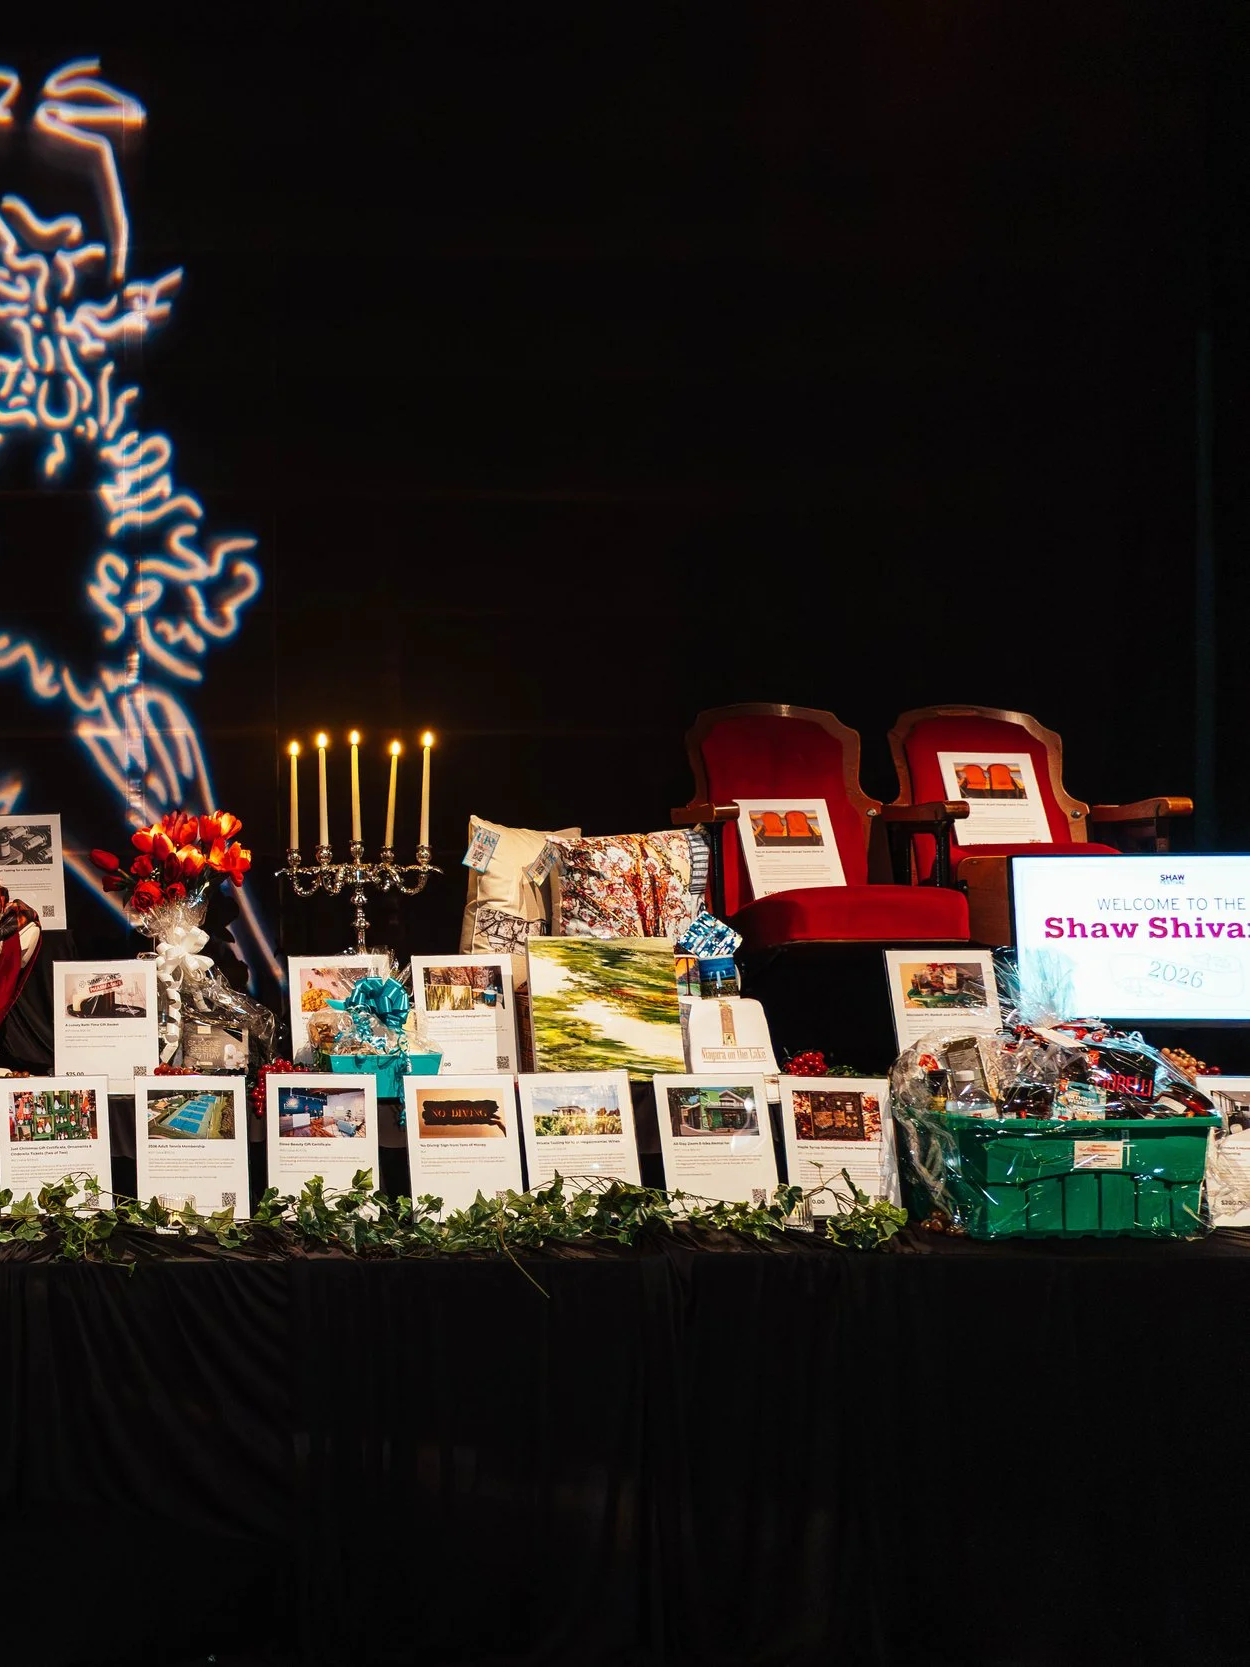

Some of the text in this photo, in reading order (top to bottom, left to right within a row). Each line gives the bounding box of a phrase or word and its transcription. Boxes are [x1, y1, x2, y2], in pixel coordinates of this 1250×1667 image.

[1097, 898, 1246, 911] WELCOME TO THE
[1044, 917, 1139, 938] Shaw
[87, 972, 122, 986] SIMPSON'S
[1148, 961, 1204, 989] 2026
[702, 1048, 766, 1062] Niagara on the Lake
[432, 1109, 487, 1118] NO DIVING
